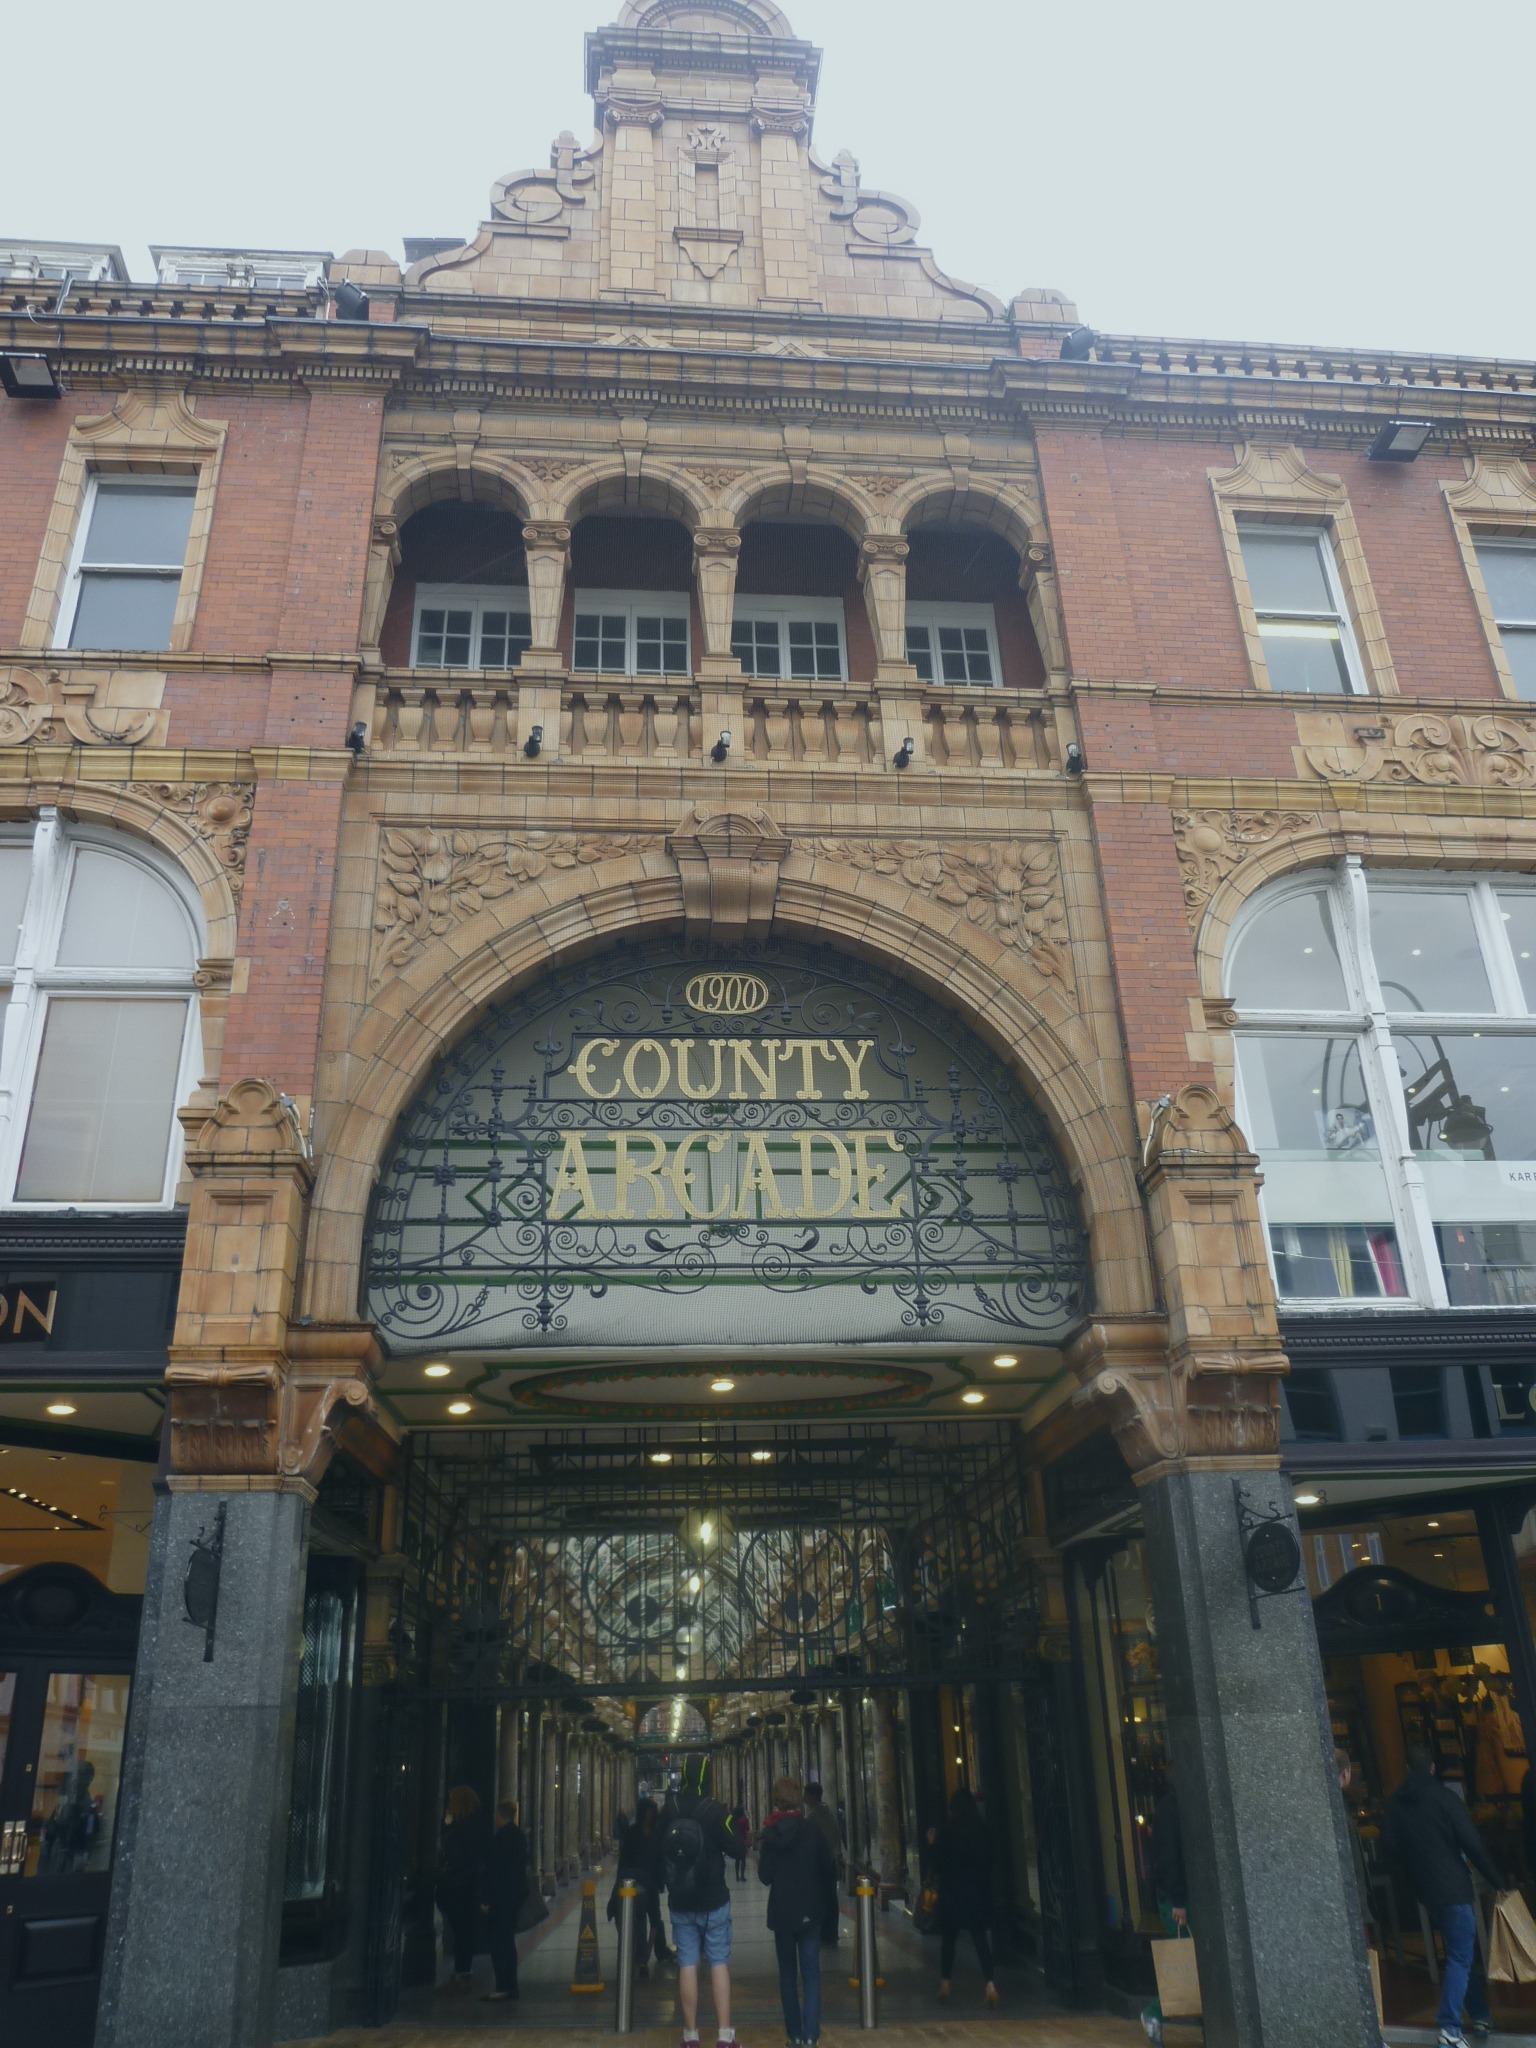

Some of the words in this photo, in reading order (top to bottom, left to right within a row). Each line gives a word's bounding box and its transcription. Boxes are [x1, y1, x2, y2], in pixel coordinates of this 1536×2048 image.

[694, 974, 757, 1012] 1900
[567, 1038, 875, 1099] COUNTY
[546, 1129, 908, 1219] ARCADE
[0, 1289, 58, 1335] N
